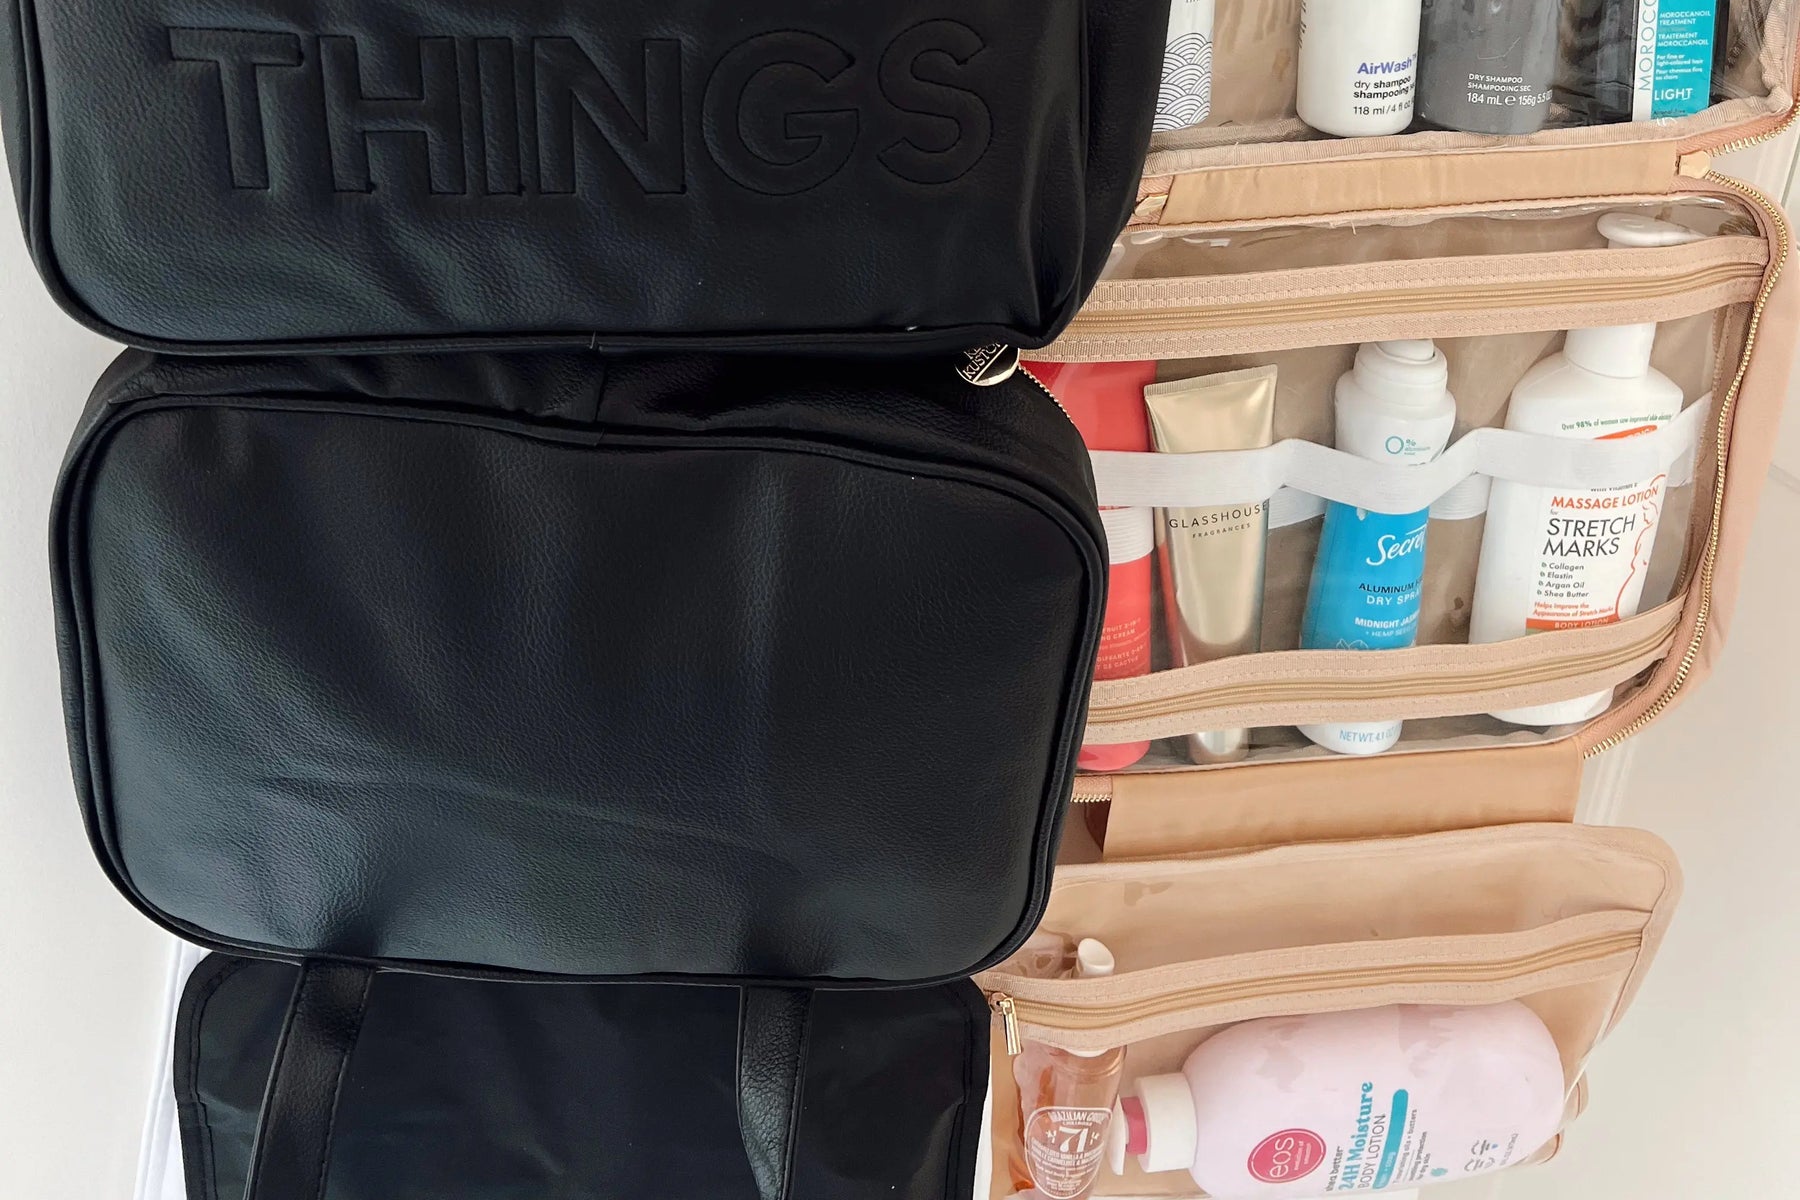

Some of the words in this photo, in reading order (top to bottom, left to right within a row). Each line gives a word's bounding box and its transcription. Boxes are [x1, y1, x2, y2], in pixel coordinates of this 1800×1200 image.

[1660, 10, 1711, 18] MOROCCANOIL
[1657, 39, 1709, 47] MOROCCANOIL
[1354, 80, 1371, 91] dry
[1373, 75, 1411, 89] shampoo
[1468, 73, 1485, 81] DRY
[1486, 75, 1523, 83] SHAMPOO
[1353, 85, 1409, 99] shampooing
[1467, 82, 1518, 92] SHAMPOOING
[1519, 84, 1532, 92] SEC
[1467, 92, 1484, 103] 184
[1486, 95, 1502, 105] mL
[1518, 95, 1537, 106] 156g
[1654, 88, 1694, 101] LIGHT
[169, 17, 994, 196] THINGS
[1353, 106, 1370, 115] 118
[962, 343, 1001, 380] KUSTO
[1576, 420, 1592, 428] 98%
[1551, 496, 1619, 510] MASSAGE
[1621, 485, 1660, 508] LOTION
[1169, 500, 1269, 529] GLASSHOUSE
[1192, 523, 1251, 539] FRAGRANCES
[1546, 513, 1636, 538] STRETCH
[1542, 537, 1620, 557] MARKS
[1549, 562, 1585, 572] Collagen
[1547, 571, 1573, 580] Elastin
[1359, 582, 1414, 594] ALUMINUM
[1545, 581, 1571, 590] Argan
[1366, 595, 1393, 606] DRY
[1397, 588, 1420, 605] SPRA
[1544, 589, 1564, 598] Shea
[1567, 590, 1589, 598] Butter
[1534, 601, 1552, 609] Helps
[1533, 609, 1570, 617] Appearance
[1354, 615, 1399, 629] MIDNIGHT
[1554, 621, 1578, 629] BODY
[1581, 617, 1609, 629] LOTION
[1340, 729, 1357, 742] NET
[1347, 1081, 1374, 1161] Moisture
[1059, 1126, 1089, 1153] 71
[1269, 1137, 1295, 1178] eos
[1357, 1162, 1375, 1189] BODY
[1366, 1113, 1386, 1160] LOTION
[1330, 1146, 1343, 1175] better
[1338, 1163, 1361, 1190] 24H
